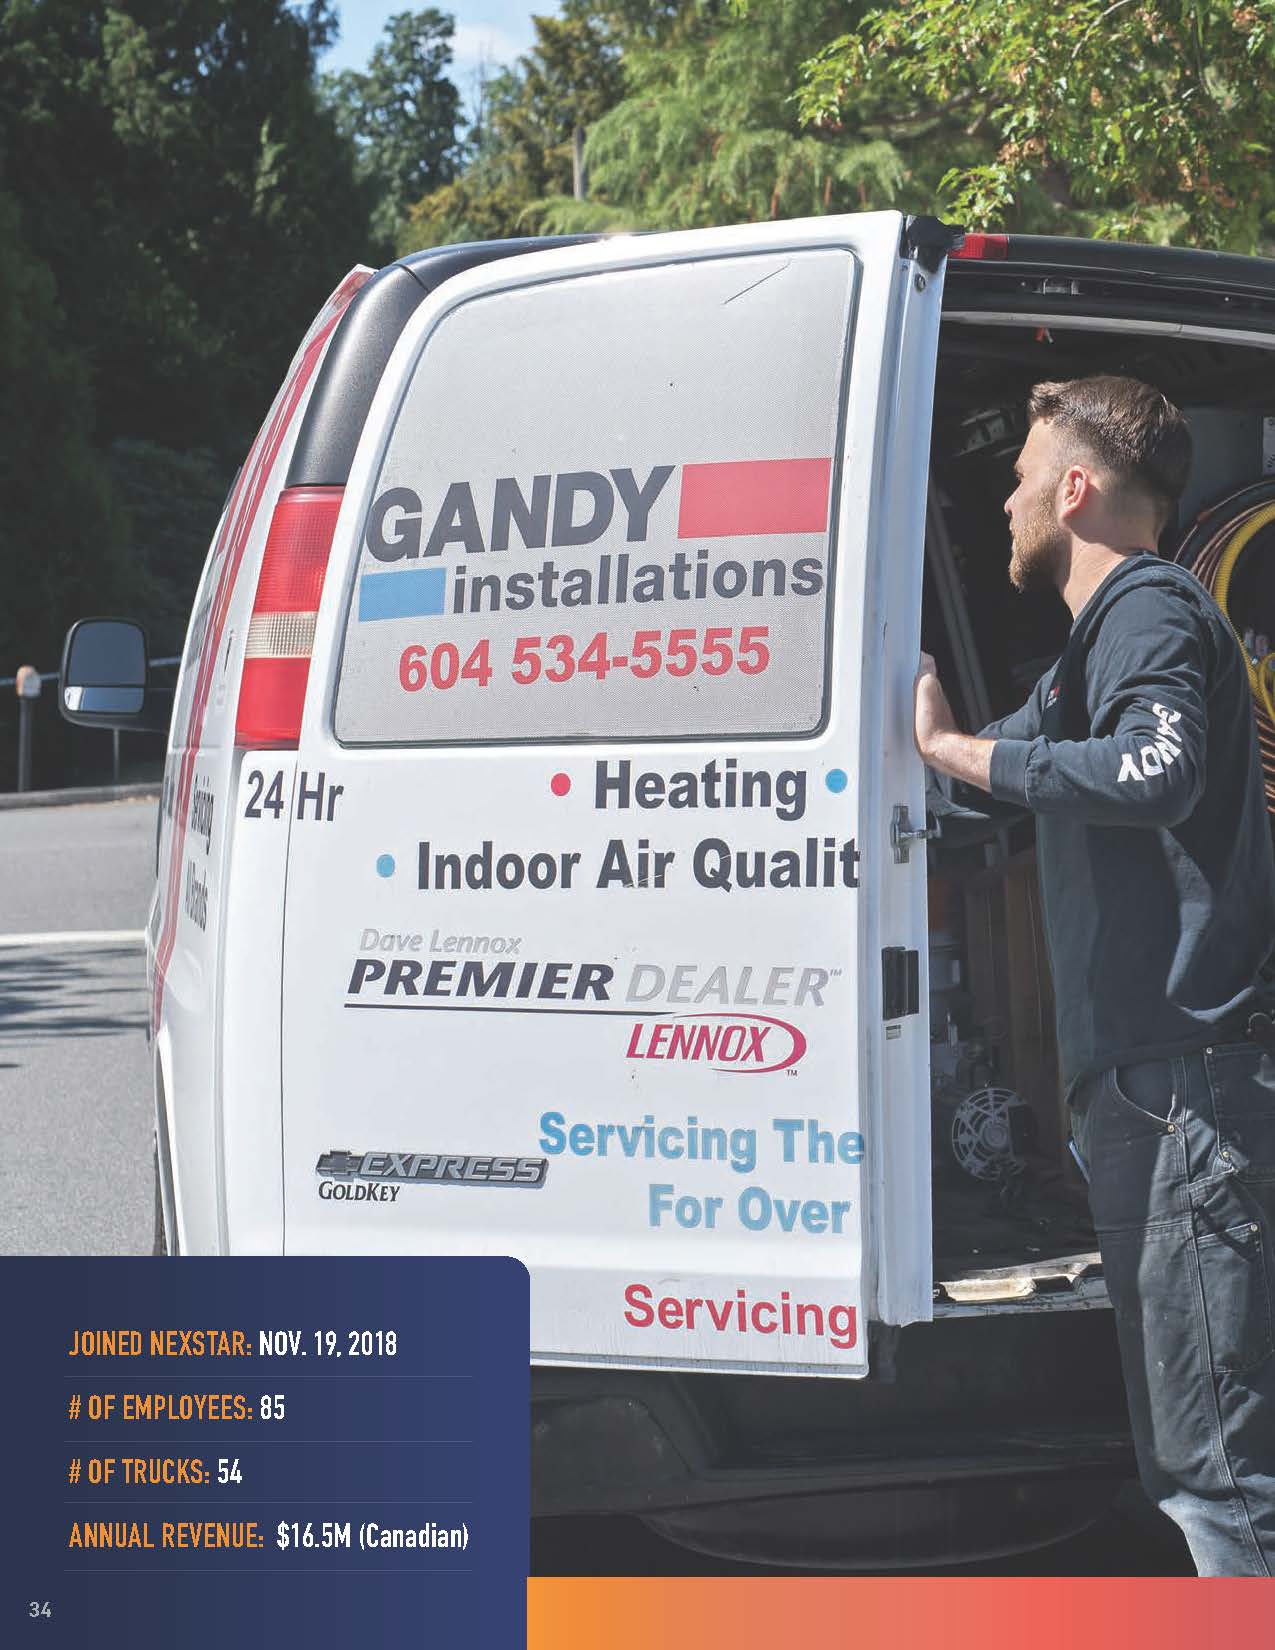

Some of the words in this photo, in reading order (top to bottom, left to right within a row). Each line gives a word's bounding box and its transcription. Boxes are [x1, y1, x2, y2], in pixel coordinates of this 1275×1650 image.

[364, 464, 677, 563] GANDY
[453, 549, 823, 614] installations
[399, 638, 493, 692] 604
[512, 626, 770, 685] 534-5555
[1117, 702, 1182, 782] GANDY
[245, 770, 284, 819] 24
[297, 771, 344, 822] Hr
[594, 758, 807, 821] Heating
[418, 840, 581, 890] Indoor
[596, 839, 675, 889] Air
[360, 928, 423, 954] Dave
[430, 929, 521, 955] Lennox
[347, 959, 614, 1001] PREMIER
[626, 1023, 772, 1064] LENNOX
[360, 1152, 542, 1183] EXPRESS
[538, 1111, 757, 1174] Servicing
[772, 1118, 865, 1165] The
[648, 1183, 724, 1230] For
[738, 1186, 850, 1235] Over
[623, 1283, 858, 1351] Servicing
